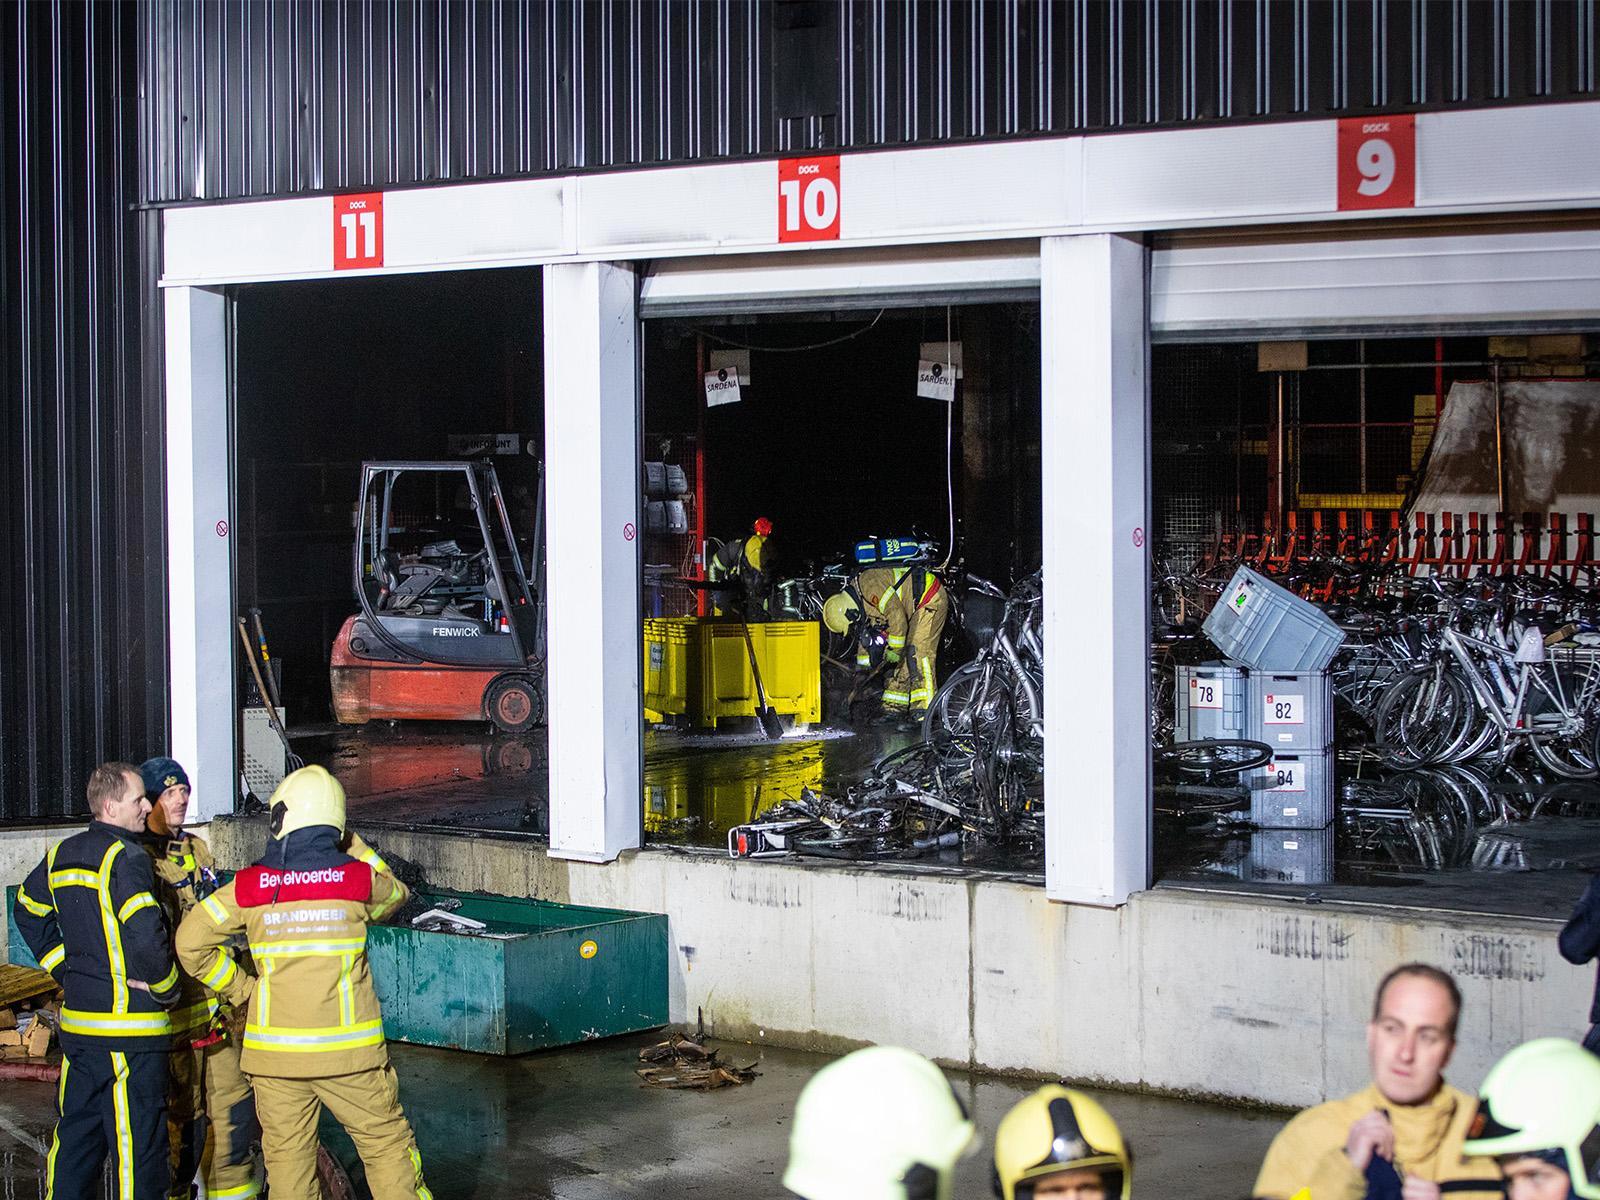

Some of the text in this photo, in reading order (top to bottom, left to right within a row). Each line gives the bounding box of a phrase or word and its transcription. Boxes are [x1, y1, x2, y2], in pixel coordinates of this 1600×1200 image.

[1362, 123, 1390, 133] DOCK
[798, 165, 820, 175] DOCK
[1356, 138, 1396, 196] 9
[350, 201, 367, 209] DOCK
[780, 177, 838, 231] 10
[341, 211, 376, 259] 11
[707, 380, 737, 392] SARDENA
[471, 440, 511, 449] INFOUNT
[432, 627, 479, 637] FENWICK
[1199, 686, 1214, 703] 78
[1275, 702, 1292, 719] 82
[1277, 769, 1294, 786] 84
[259, 867, 346, 889] Bevelvoerder
[262, 908, 347, 925] BRANDWEER
